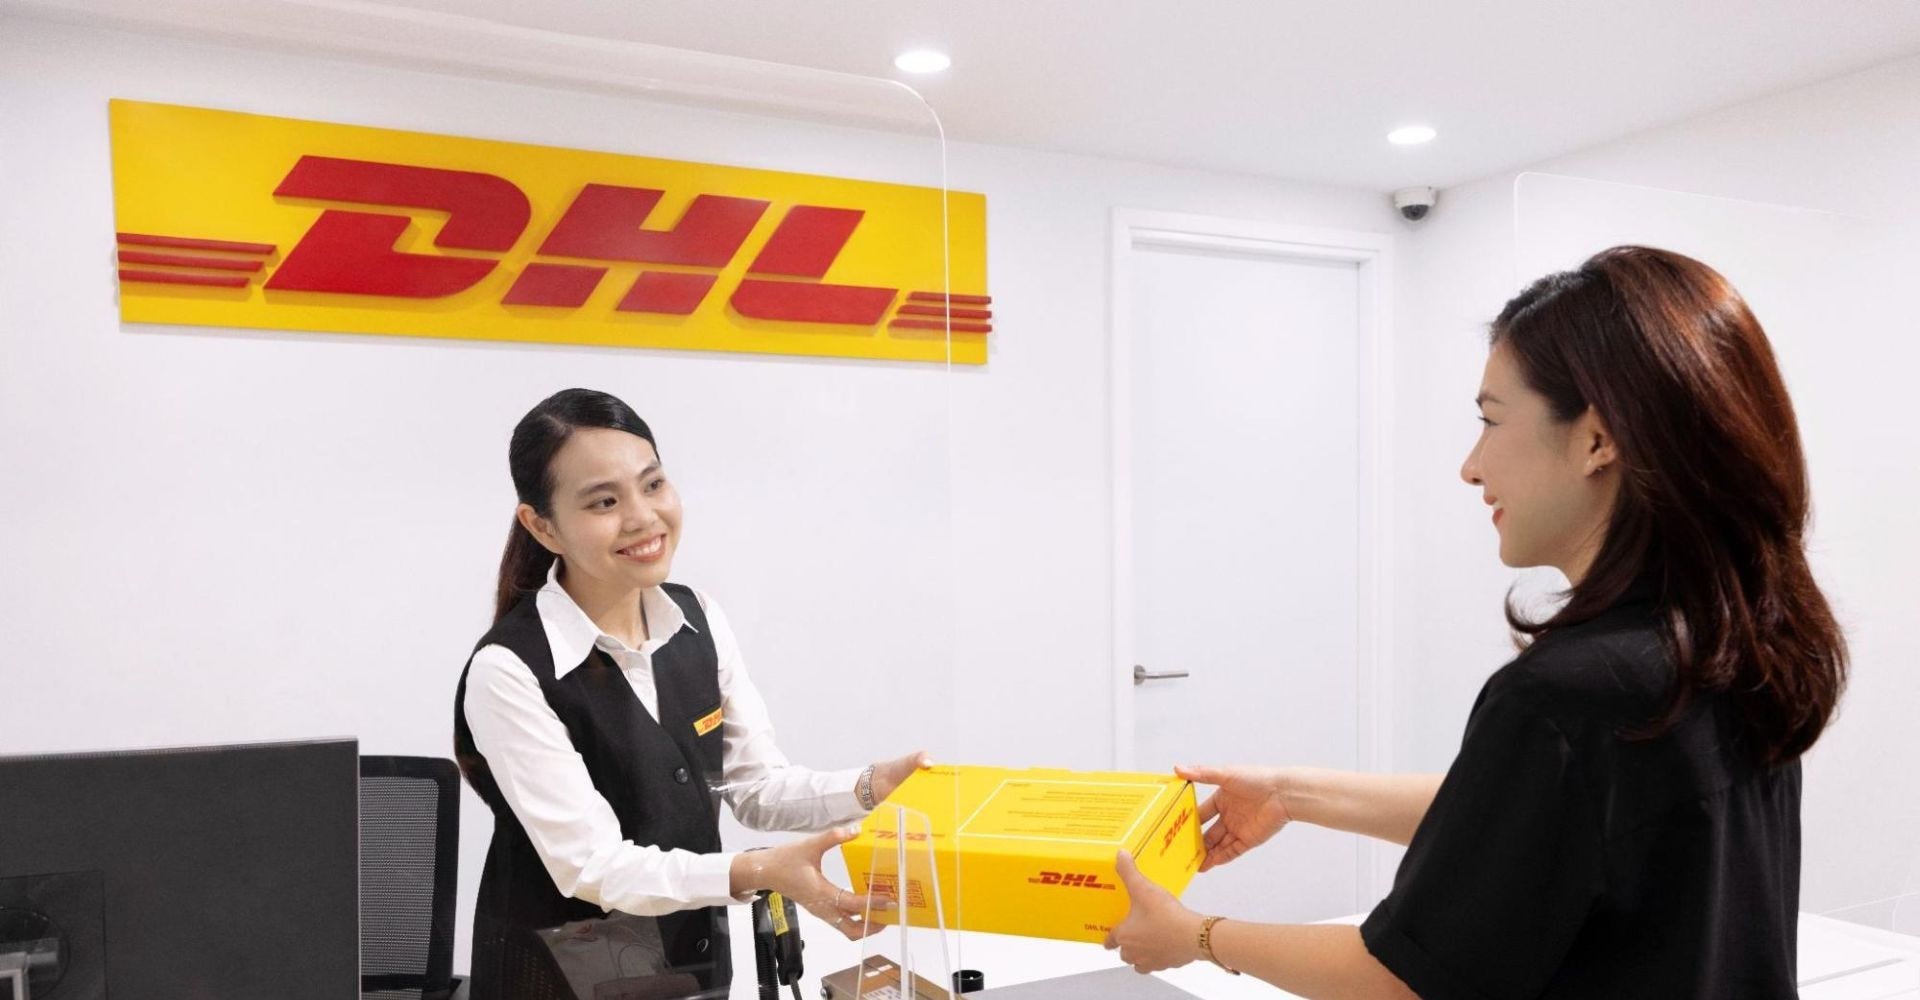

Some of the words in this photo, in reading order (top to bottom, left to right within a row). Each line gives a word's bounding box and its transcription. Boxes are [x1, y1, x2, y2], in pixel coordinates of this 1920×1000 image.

[264, 155, 898, 325] DHL
[702, 710, 722, 729] DH
[1164, 808, 1189, 849] DHL
[1040, 872, 1102, 888] DHL
